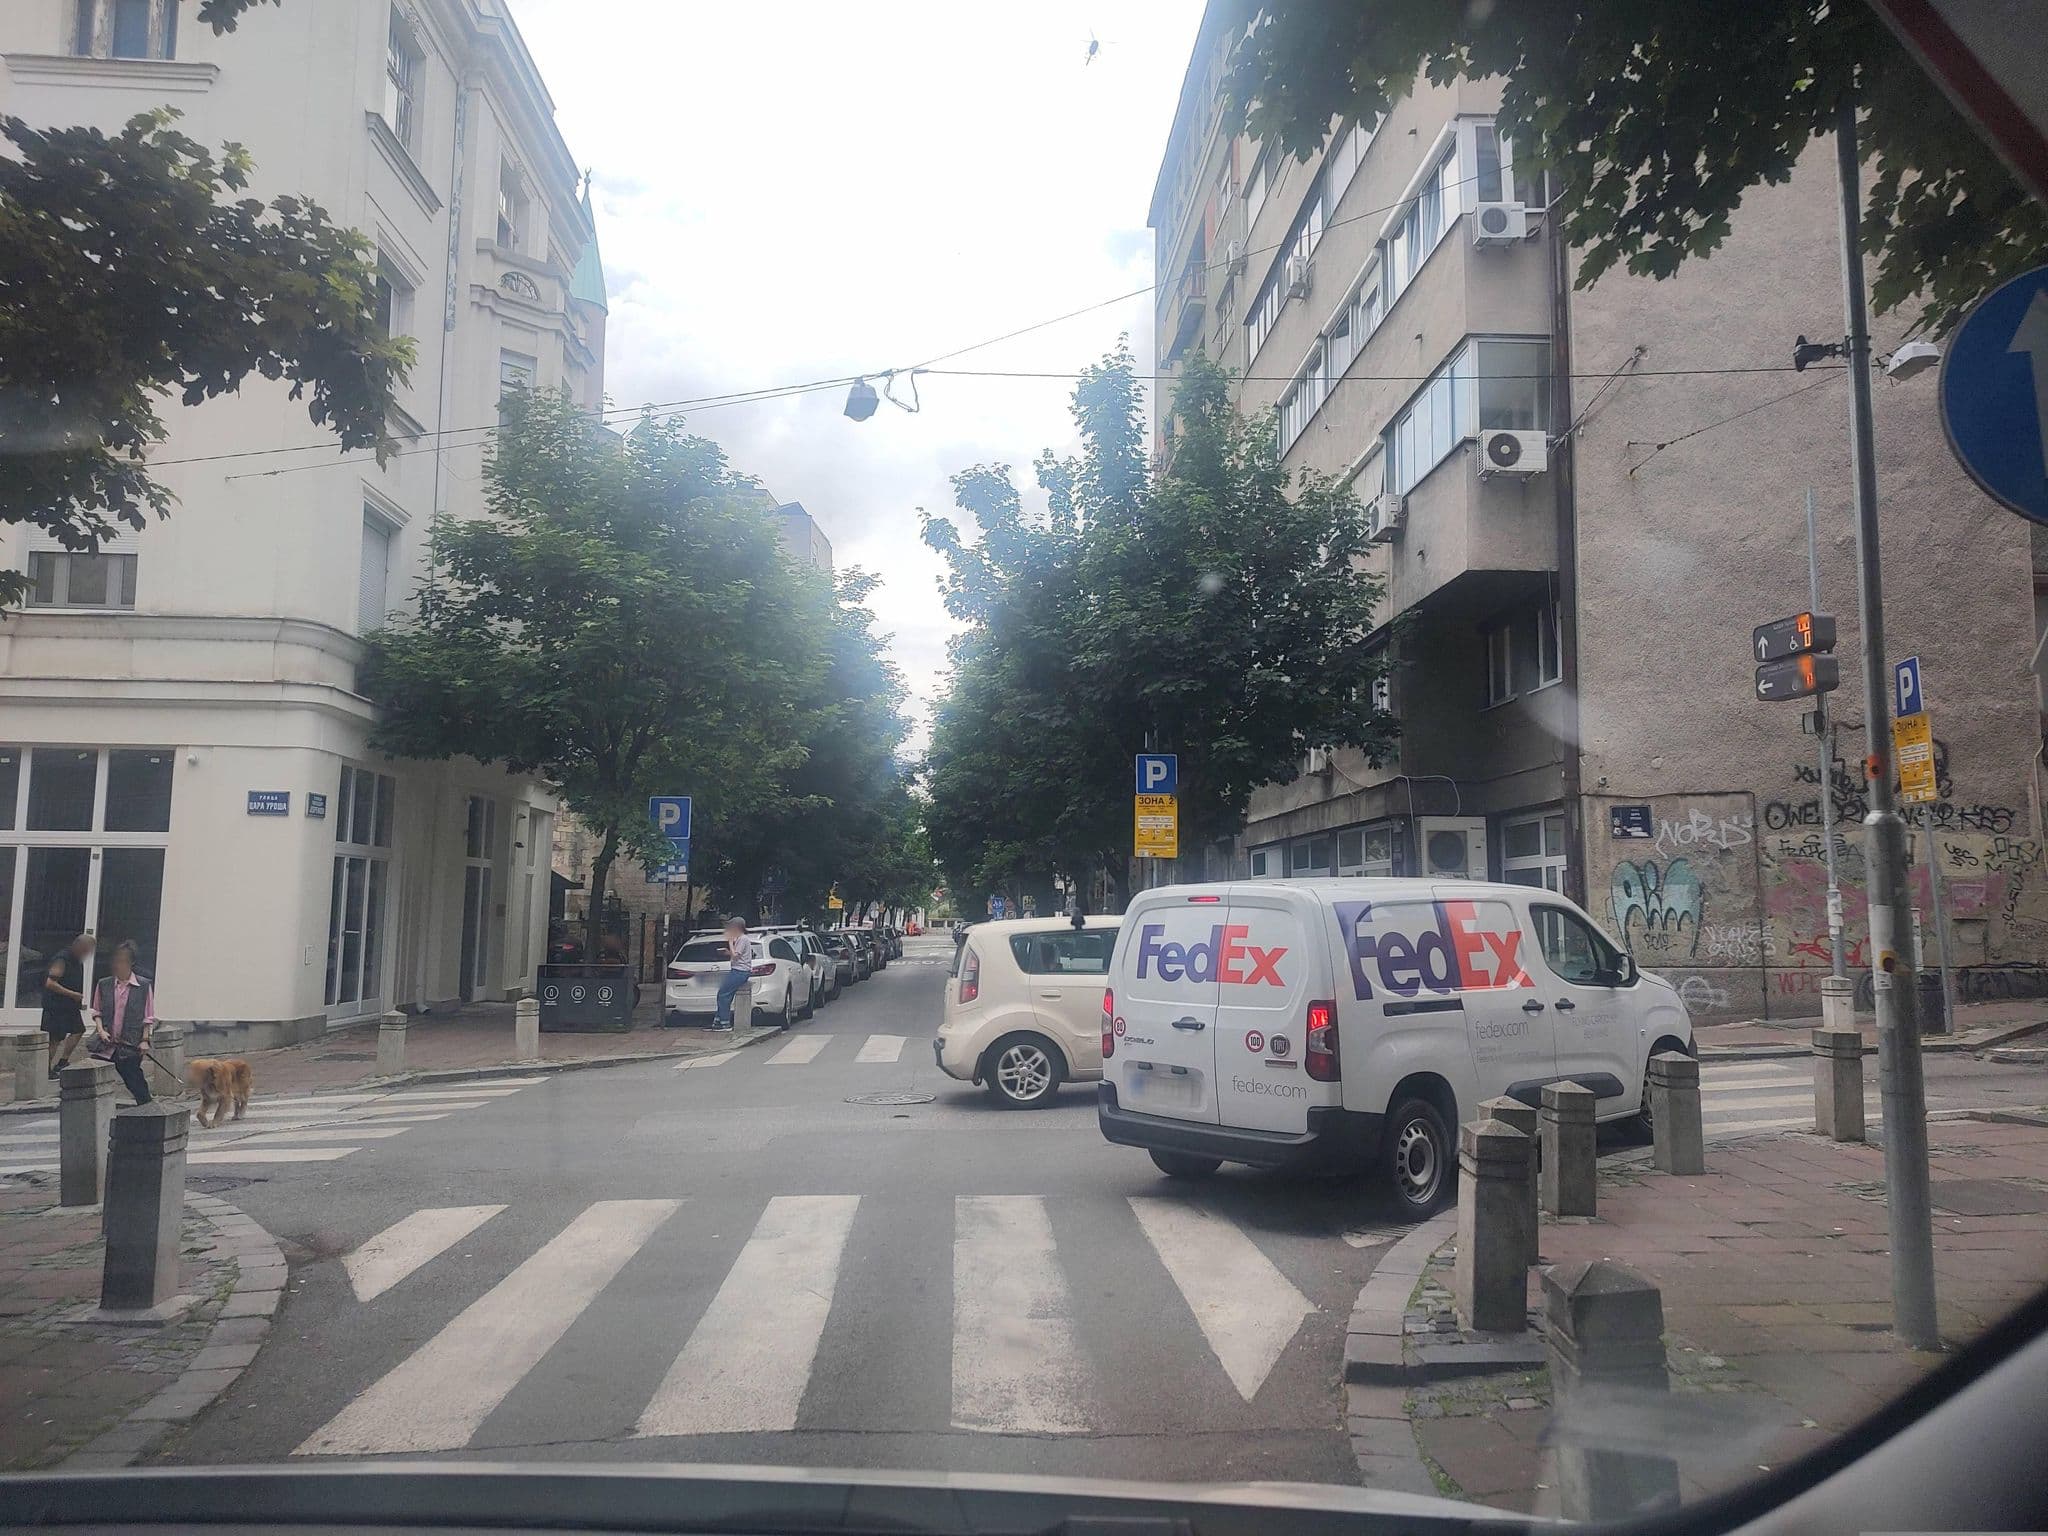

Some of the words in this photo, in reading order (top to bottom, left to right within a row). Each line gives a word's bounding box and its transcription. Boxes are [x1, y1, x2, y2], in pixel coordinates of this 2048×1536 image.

[1898, 666, 1914, 711] P
[1146, 760, 1168, 789] P
[249, 801, 265, 811] ЦАРА
[266, 802, 287, 811] УРОША
[1138, 796, 1164, 805] ЗОНА
[1168, 797, 1175, 805] 2
[658, 802, 681, 833] P
[1136, 924, 1288, 987] FedEx
[1332, 900, 1537, 1001] FedEx
[1250, 1036, 1261, 1048] 100
[1231, 1075, 1307, 1100] fedex.com
